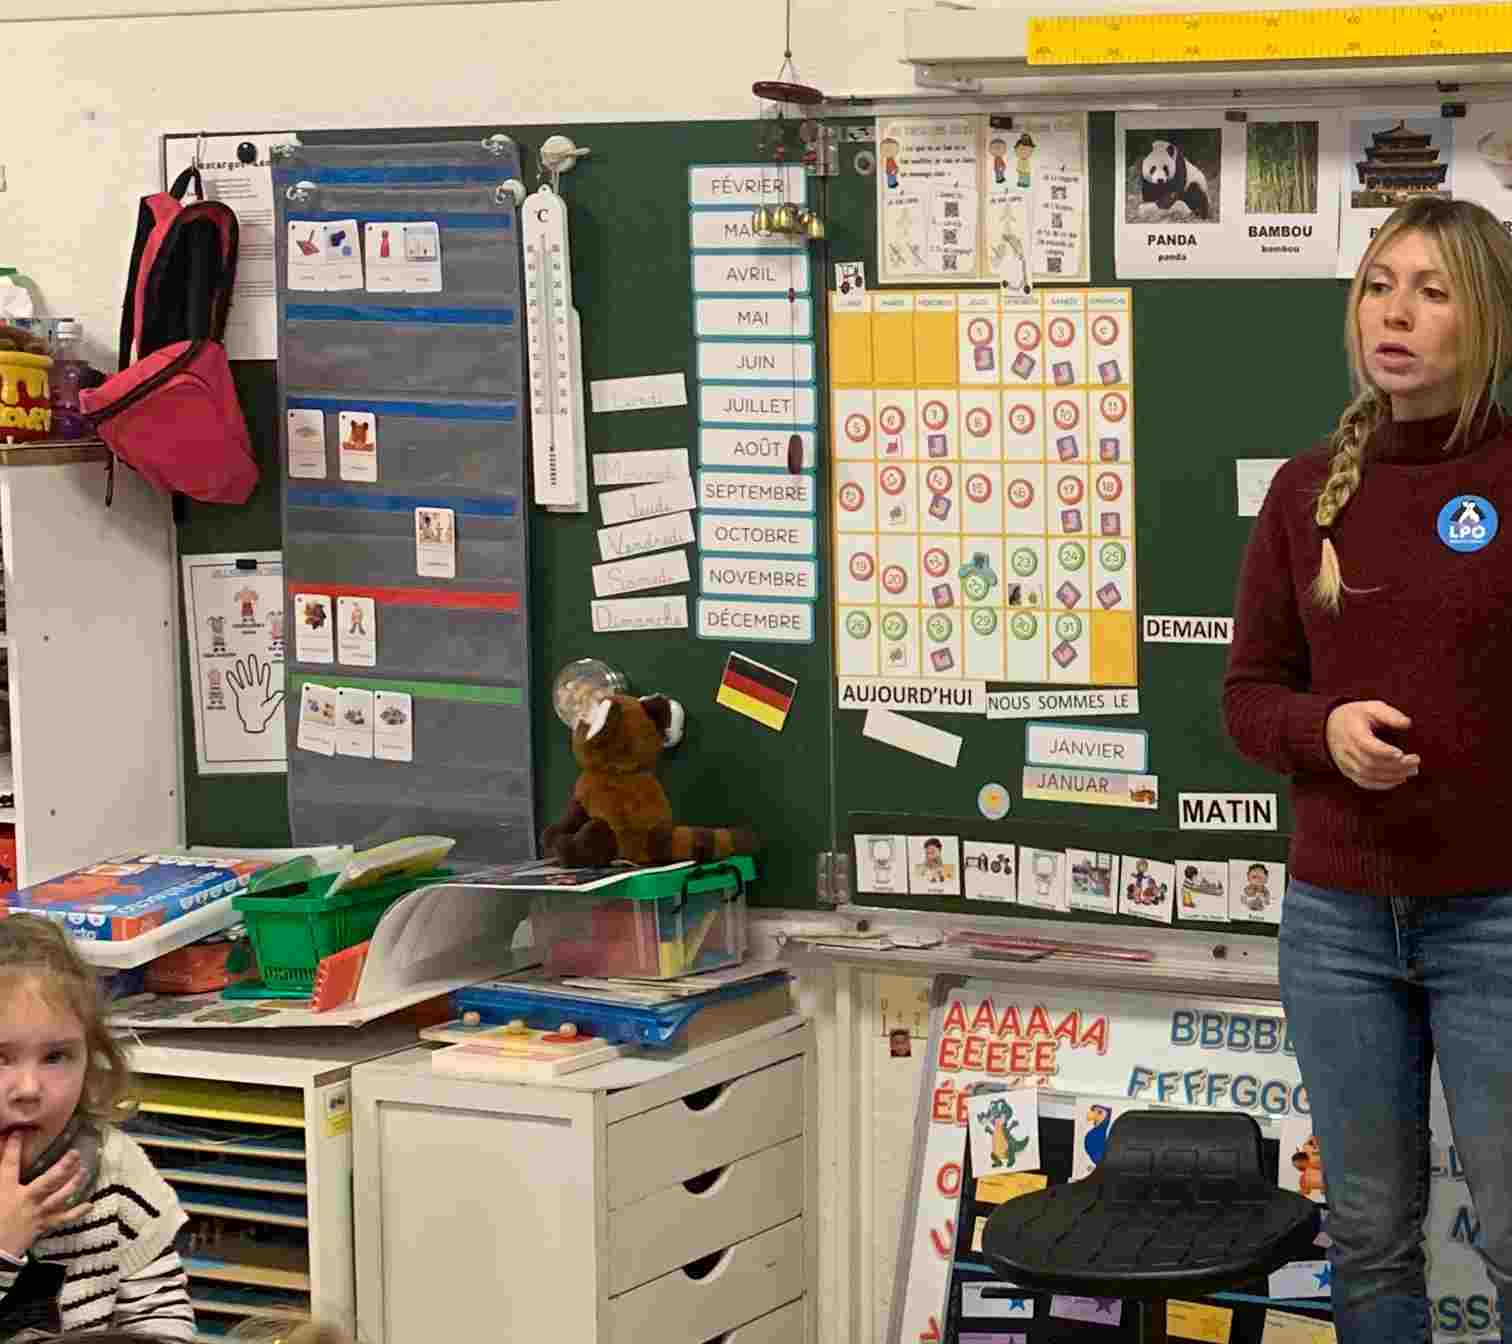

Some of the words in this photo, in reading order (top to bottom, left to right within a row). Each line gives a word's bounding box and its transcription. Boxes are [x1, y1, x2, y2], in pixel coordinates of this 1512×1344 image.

[710, 175, 785, 194] FÉVRIER
[1148, 234, 1197, 246] PANDA
[1248, 225, 1313, 238] BAMBOU
[1158, 253, 1187, 263] panda
[1261, 244, 1301, 254] bambou
[725, 267, 776, 282] AVRIL
[736, 310, 769, 326] MAI
[735, 354, 776, 369] JUIN
[722, 398, 792, 415] JUILLET
[732, 435, 782, 457] AOÛT
[704, 484, 809, 502] SEPTEMBRE
[714, 527, 801, 545] OCTOBRE
[1449, 525, 1486, 539] LPO
[709, 569, 809, 588] NOVEMBRE
[707, 609, 802, 631] DÉCEMBRE
[1147, 620, 1229, 640] DEMAIN
[843, 684, 973, 707] AUJOURD'HUI
[988, 694, 1031, 712] NOUS
[1038, 694, 1105, 711] SOMMES
[1114, 693, 1130, 709] LE
[1048, 739, 1126, 759] JANVIER
[1036, 772, 1110, 794] JANUAR
[1183, 799, 1272, 824] MATIN
